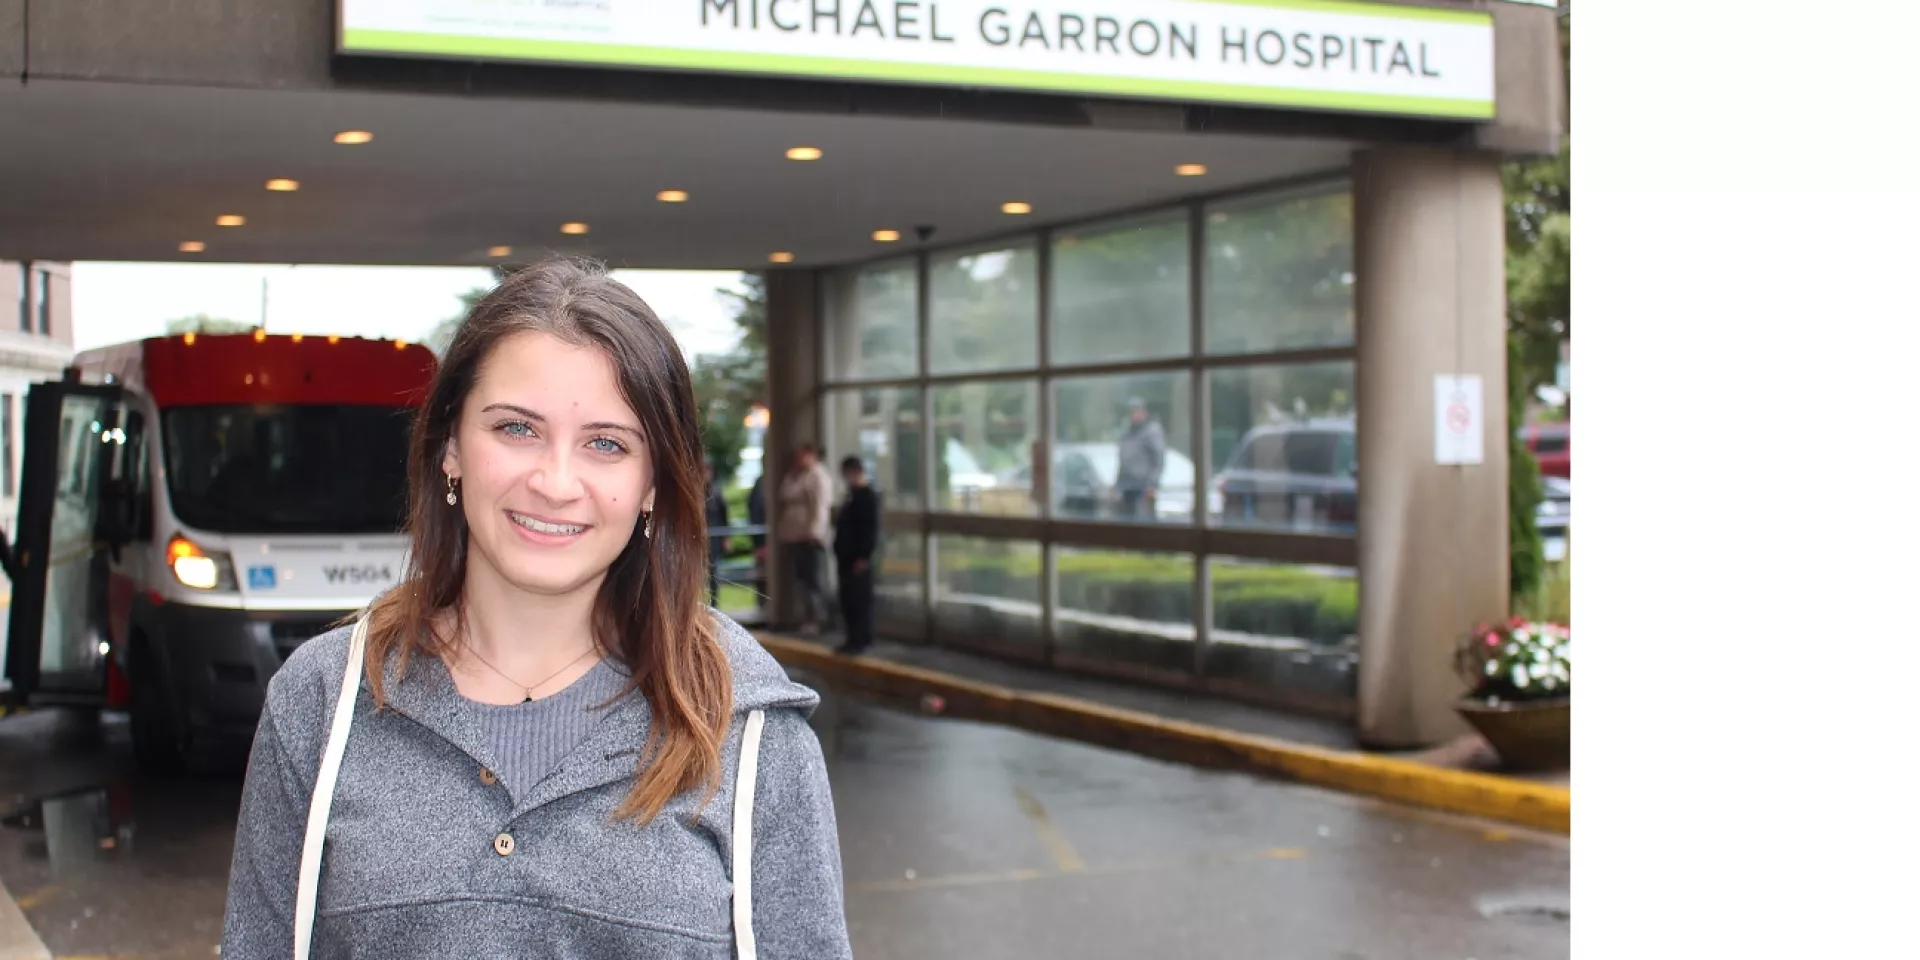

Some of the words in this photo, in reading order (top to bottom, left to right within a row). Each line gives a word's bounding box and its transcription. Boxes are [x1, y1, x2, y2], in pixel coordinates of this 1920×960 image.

[699, 0, 954, 42] MICHAEL
[979, 8, 1197, 59] GARRON
[1220, 26, 1440, 77] HOSPITAL
